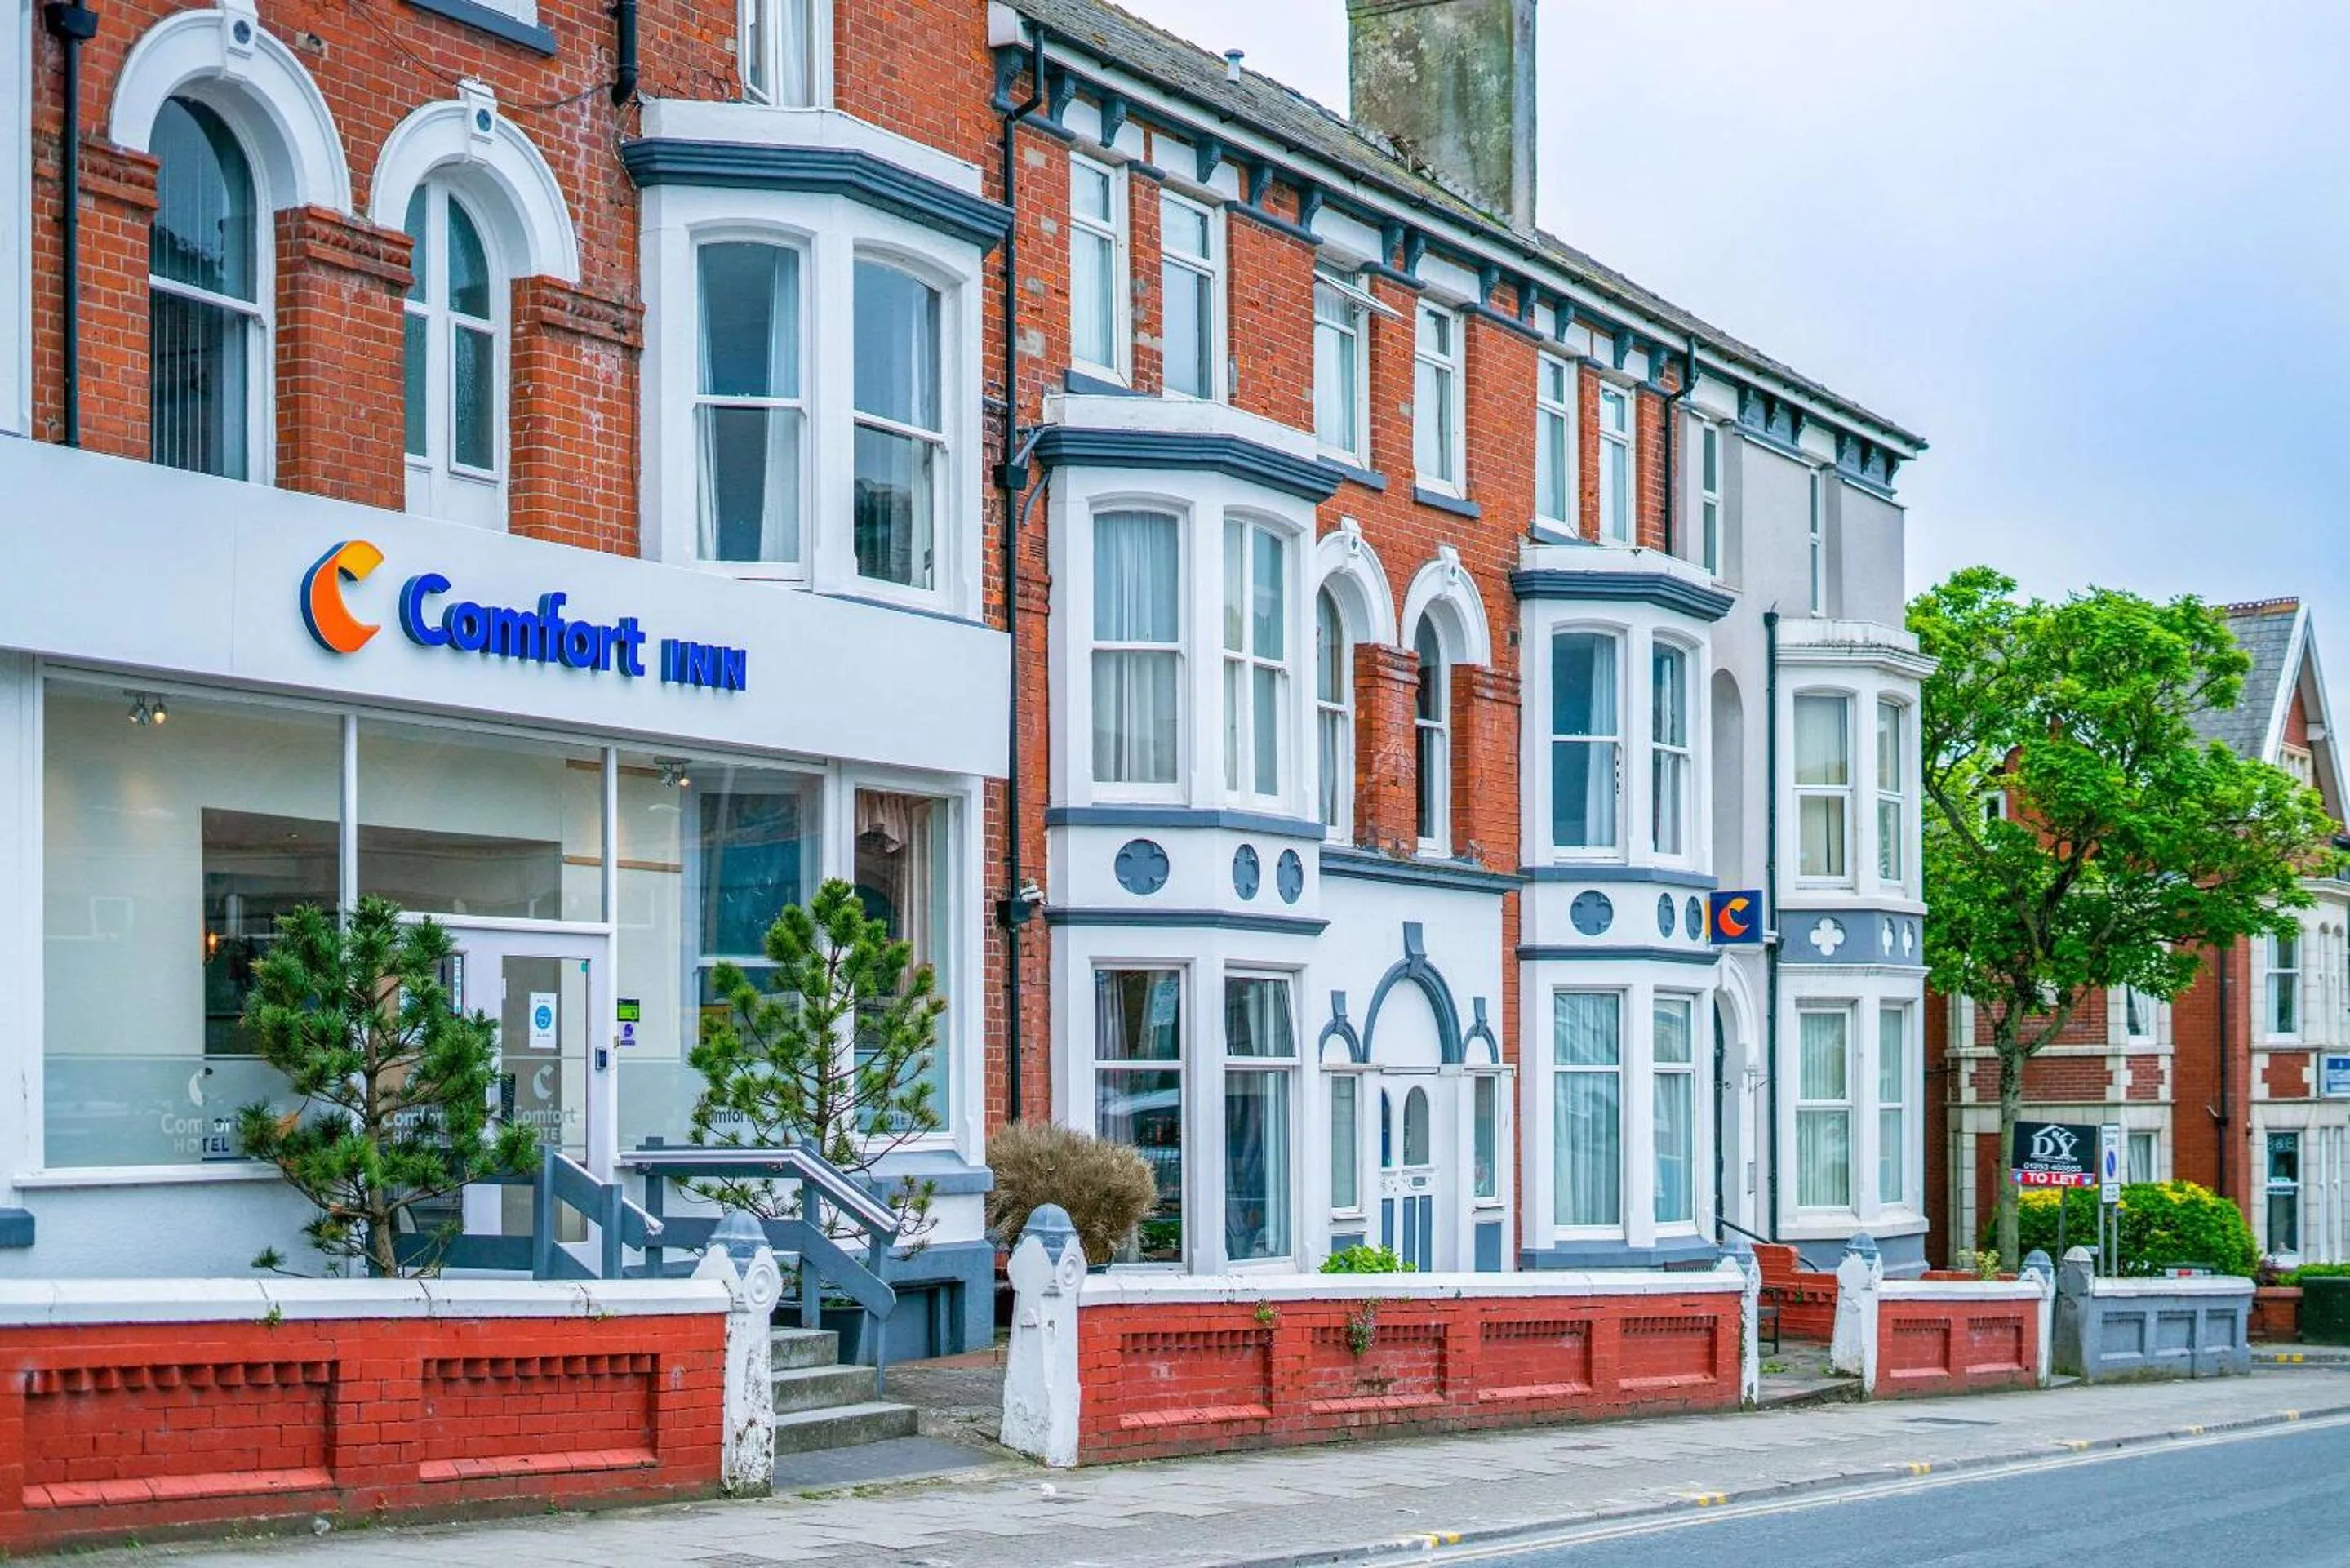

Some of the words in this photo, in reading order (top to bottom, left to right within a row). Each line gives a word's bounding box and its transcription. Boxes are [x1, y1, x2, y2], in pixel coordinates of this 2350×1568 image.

[399, 574, 645, 677] Comfort
[661, 639, 747, 691] INN
[174, 1136, 229, 1153] HOTEL
[2028, 1173, 2048, 1184] TO
[2051, 1174, 2078, 1185] LET
